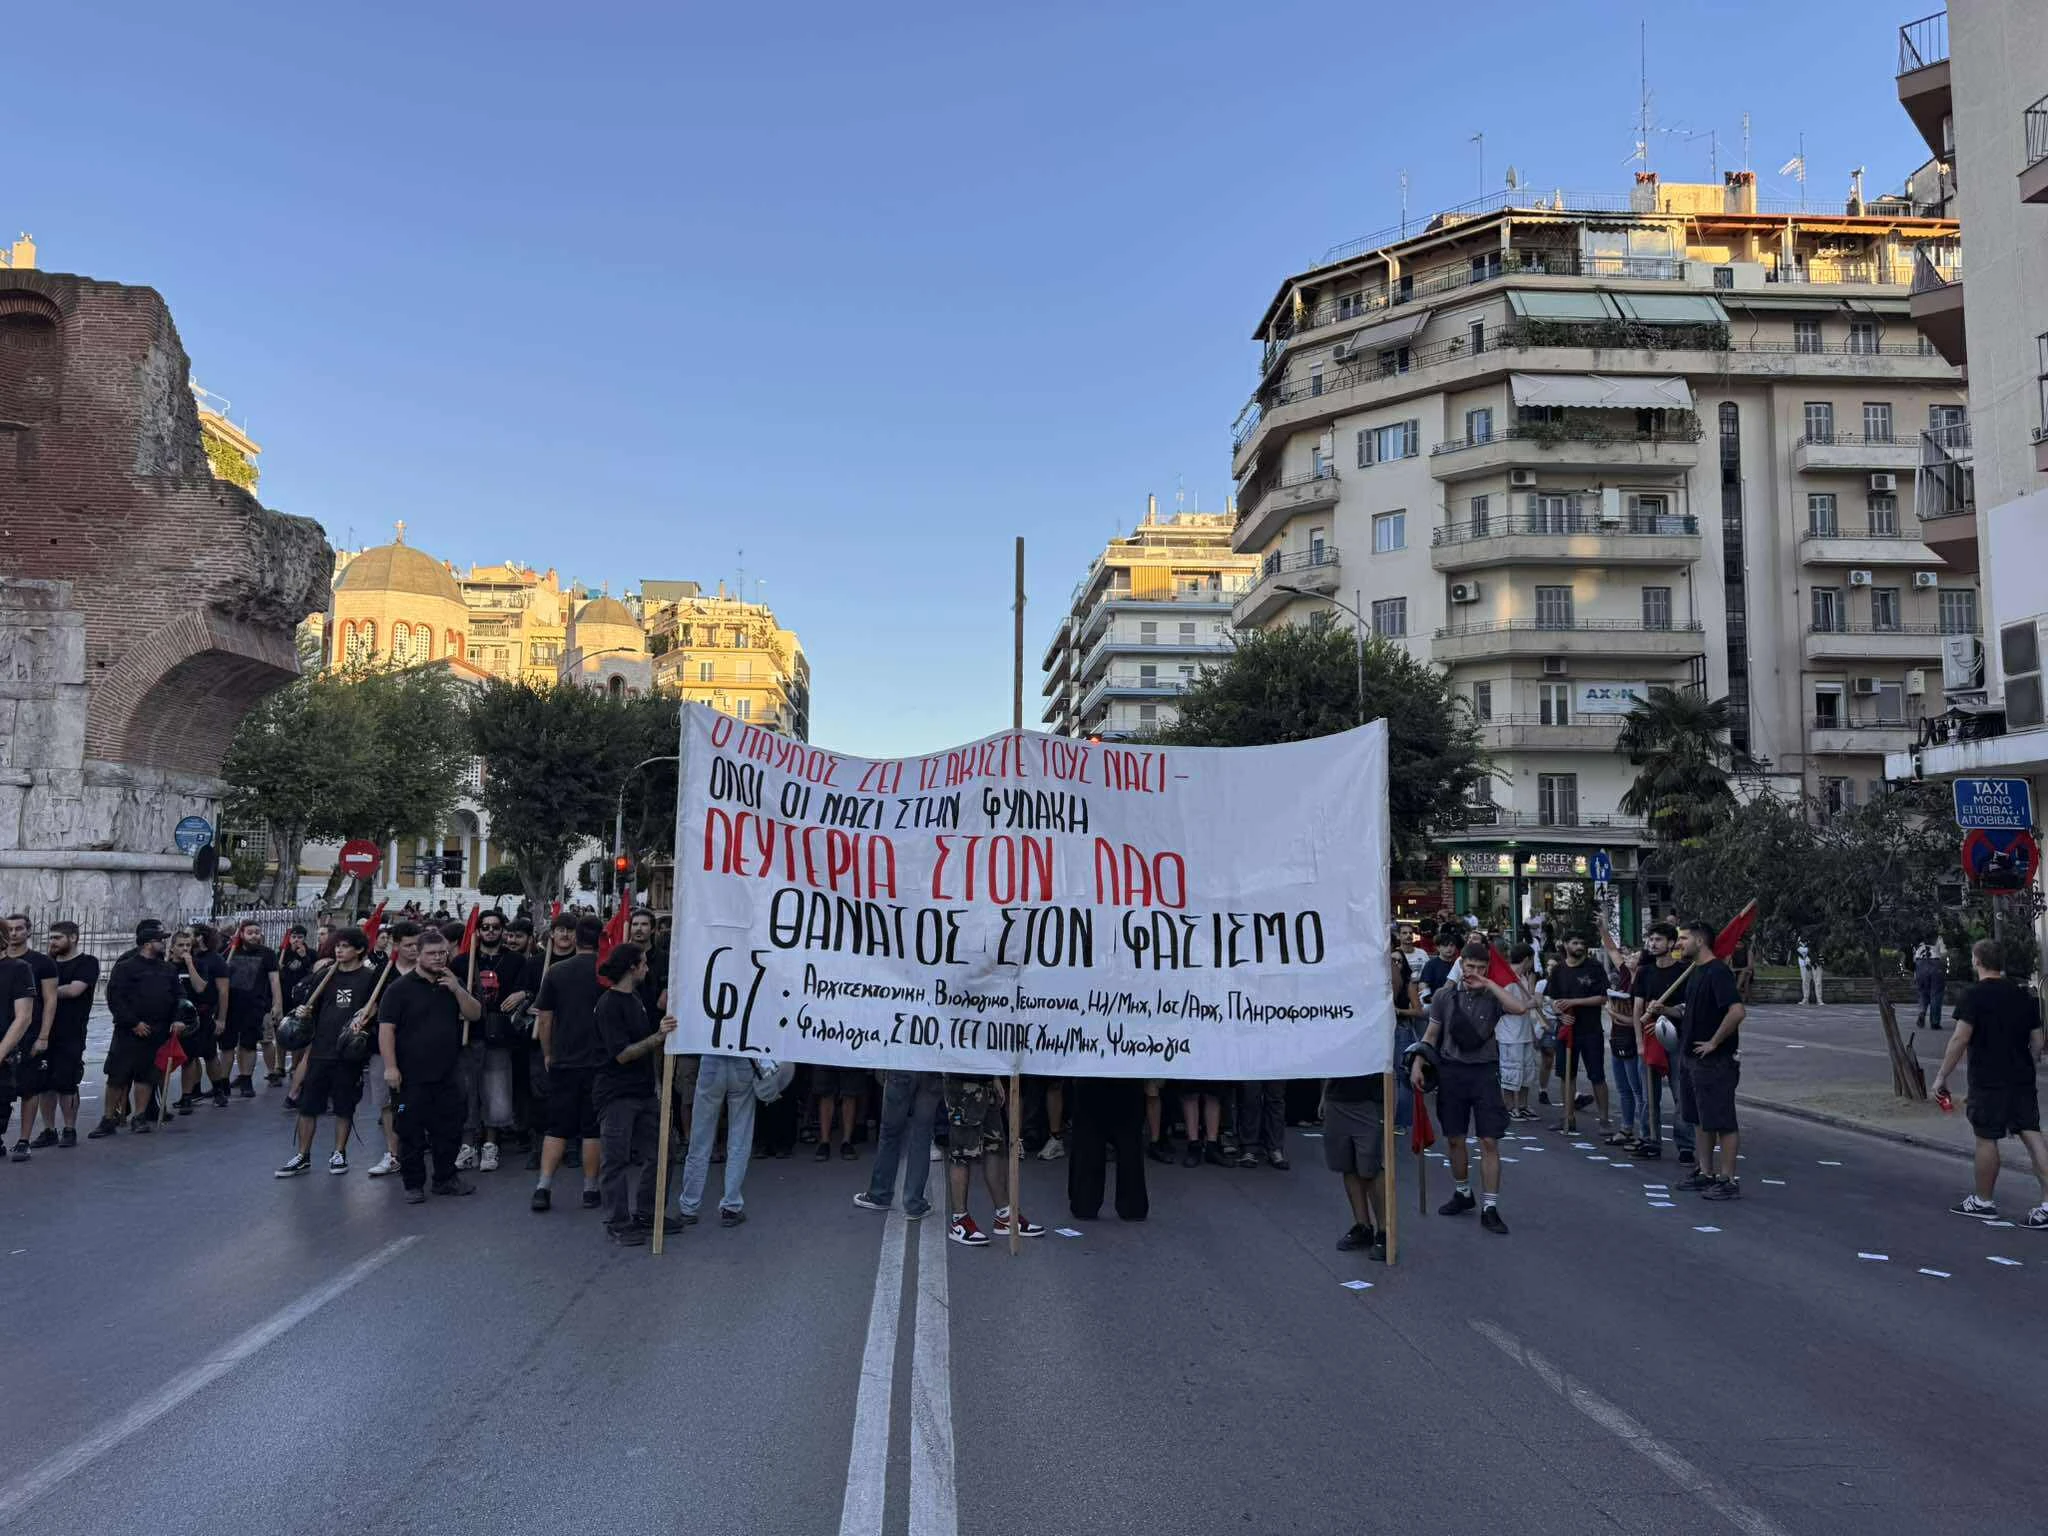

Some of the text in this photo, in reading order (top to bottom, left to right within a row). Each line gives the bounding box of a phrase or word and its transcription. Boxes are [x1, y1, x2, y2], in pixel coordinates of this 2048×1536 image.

[711, 715, 733, 748] Ο
[738, 726, 848, 788] ΠΑΥΛΟΣ
[857, 760, 903, 794] ΖΕΙ
[919, 735, 1028, 792] ΤΣΑΚΙΣΤΕ
[1039, 738, 1093, 784] ΤΟΥΣ
[709, 756, 1089, 834] ΟΛΟΙ ΟΙ ΝΑΖΙ ΣΤΗΝ ΦΥΛΑΚΗ
[703, 807, 1186, 909] ΛΕΥΤΕΡΙΑ ΣΤΟΝ ΛΑΟ
[1540, 852, 1573, 865] GREEK
[770, 887, 1326, 971] ΘΑΝΑΤΟΣ ΣΤΟΝ ΦΑΣΙΣΜΟ
[1106, 1020, 1192, 1063] Ψυχολογια
